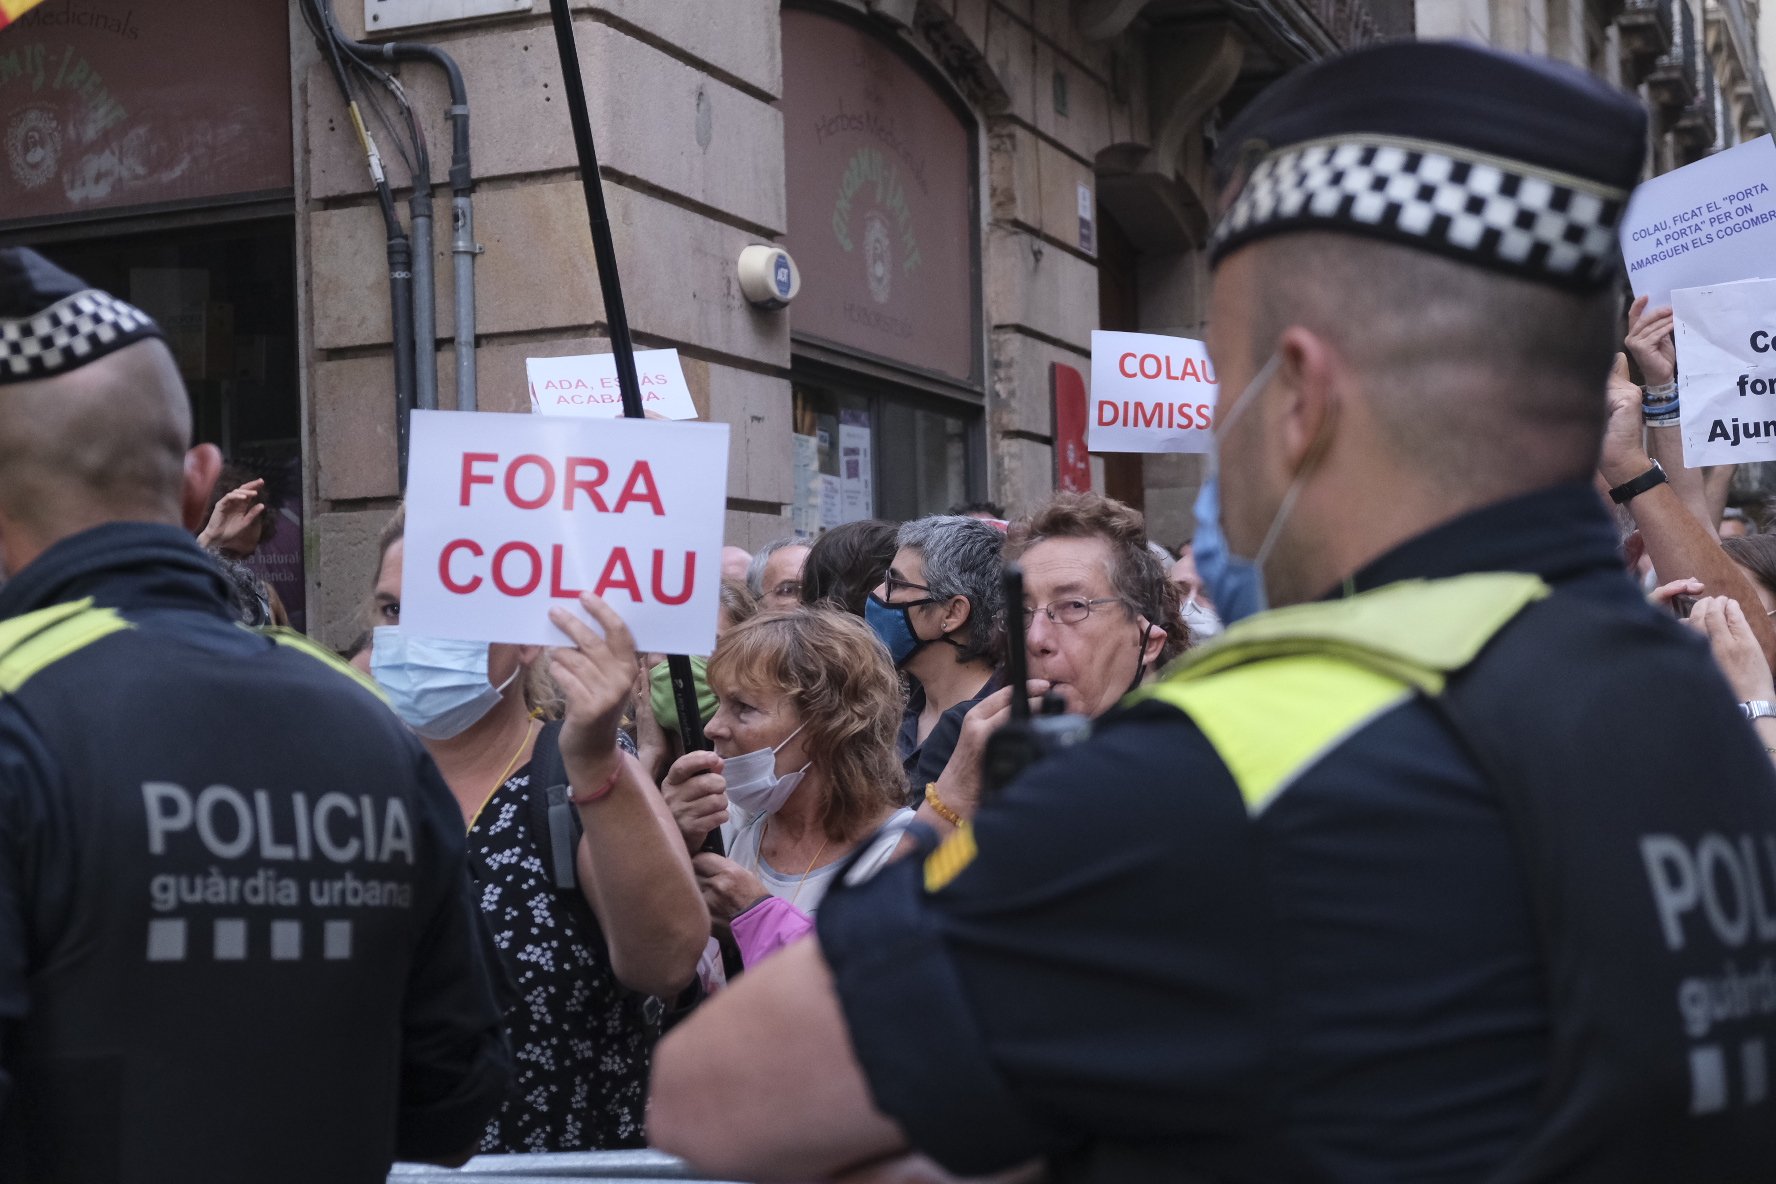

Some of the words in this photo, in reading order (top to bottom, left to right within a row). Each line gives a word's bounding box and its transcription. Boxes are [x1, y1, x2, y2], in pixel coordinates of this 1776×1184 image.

[1632, 219, 1672, 242] COLAU,
[1672, 206, 1704, 226] FICAT
[1705, 201, 1722, 213] EL
[1722, 183, 1769, 205] "PORTA
[1655, 238, 1664, 248] A
[1664, 220, 1706, 244] PORTA"
[1709, 211, 1733, 227] PER
[1735, 203, 1753, 217] ON
[1630, 243, 1690, 272] AMARGUEN
[1691, 233, 1714, 249] ELS
[1716, 209, 1776, 240] COGOMBR
[544, 378, 594, 391] ADA,
[1118, 351, 1219, 385] COLAU
[556, 390, 665, 405] ACABA.
[458, 451, 666, 517] FORA
[438, 537, 697, 606] COLAU
[141, 780, 416, 866] POLICIA
[149, 865, 300, 913] guàrdia
[309, 869, 414, 909] urbana
